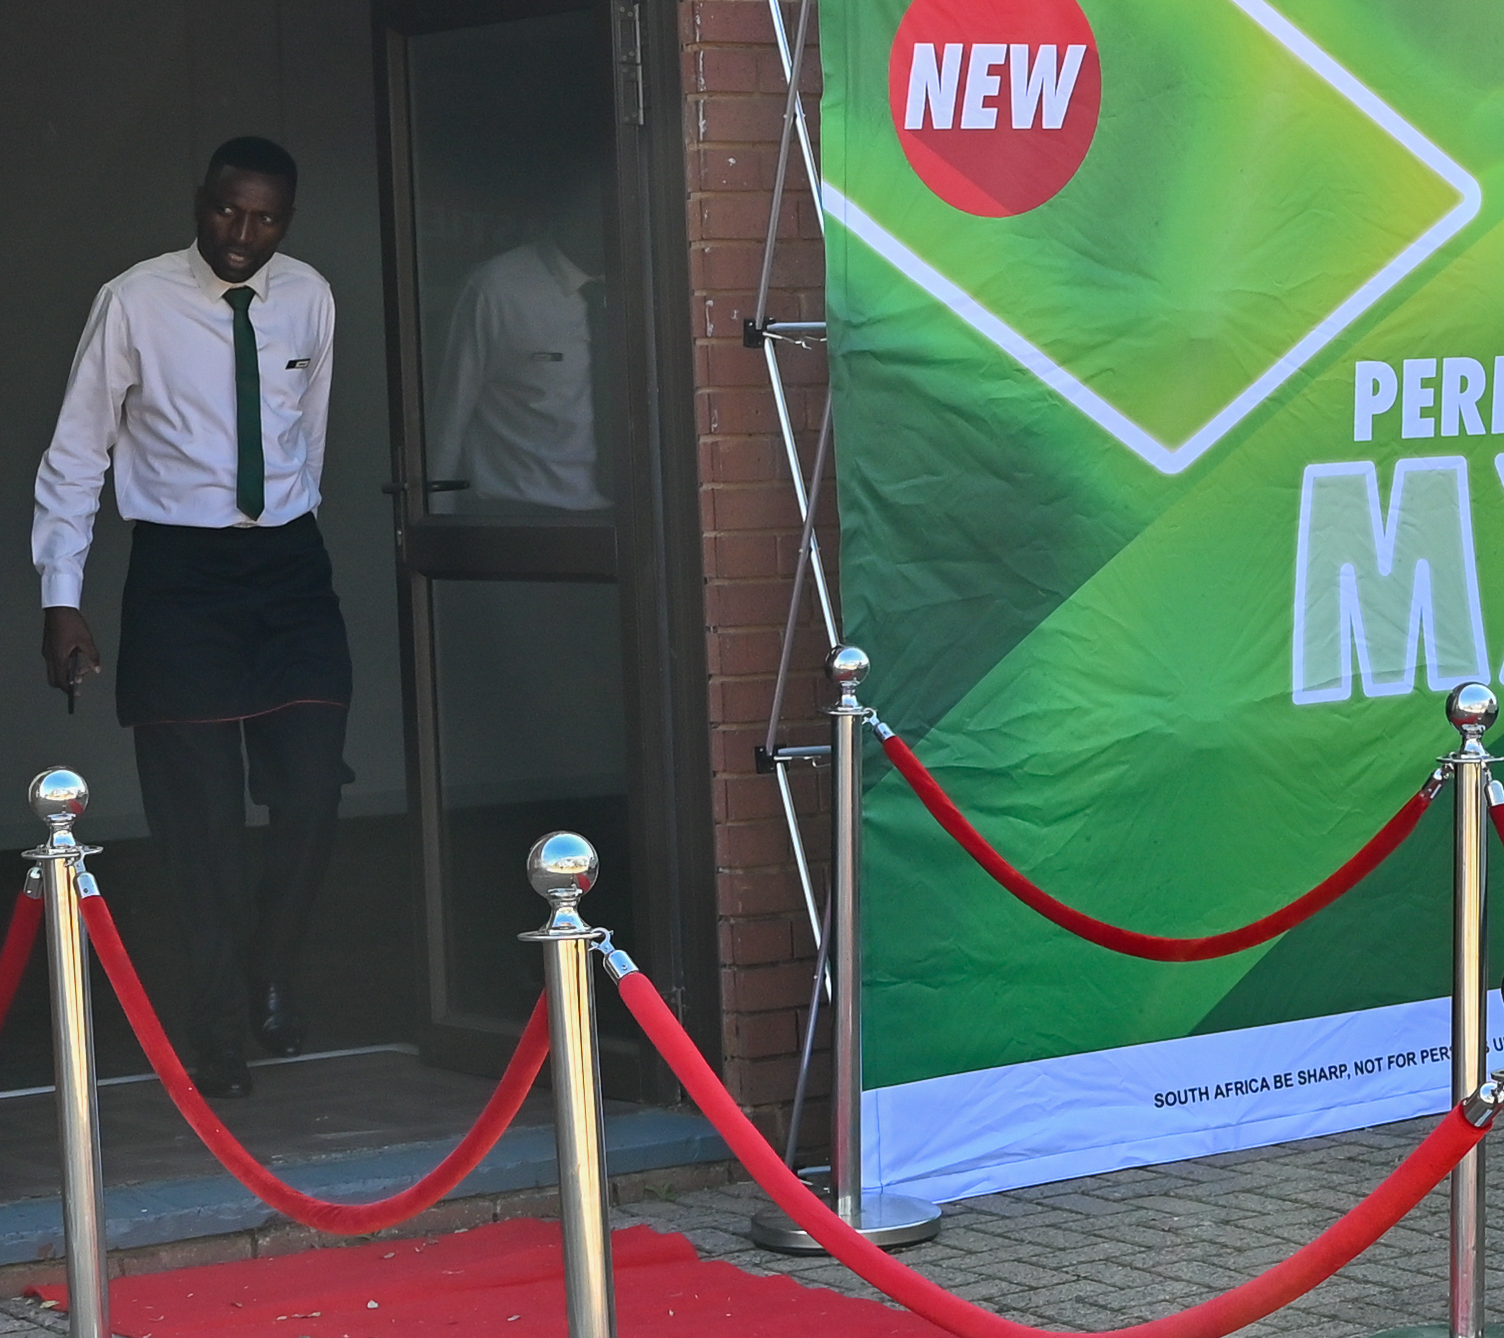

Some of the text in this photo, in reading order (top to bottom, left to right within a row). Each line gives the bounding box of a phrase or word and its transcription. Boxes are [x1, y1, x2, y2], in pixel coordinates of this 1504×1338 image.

[904, 42, 1088, 130] NEW
[1154, 1086, 1210, 1108] SOUTH
[1214, 1077, 1271, 1100] AFRICA
[1274, 1072, 1294, 1090] BE
[1297, 1064, 1351, 1085] SHARP,
[1354, 1057, 1384, 1076] NOT
[1387, 1052, 1418, 1071] FOR
